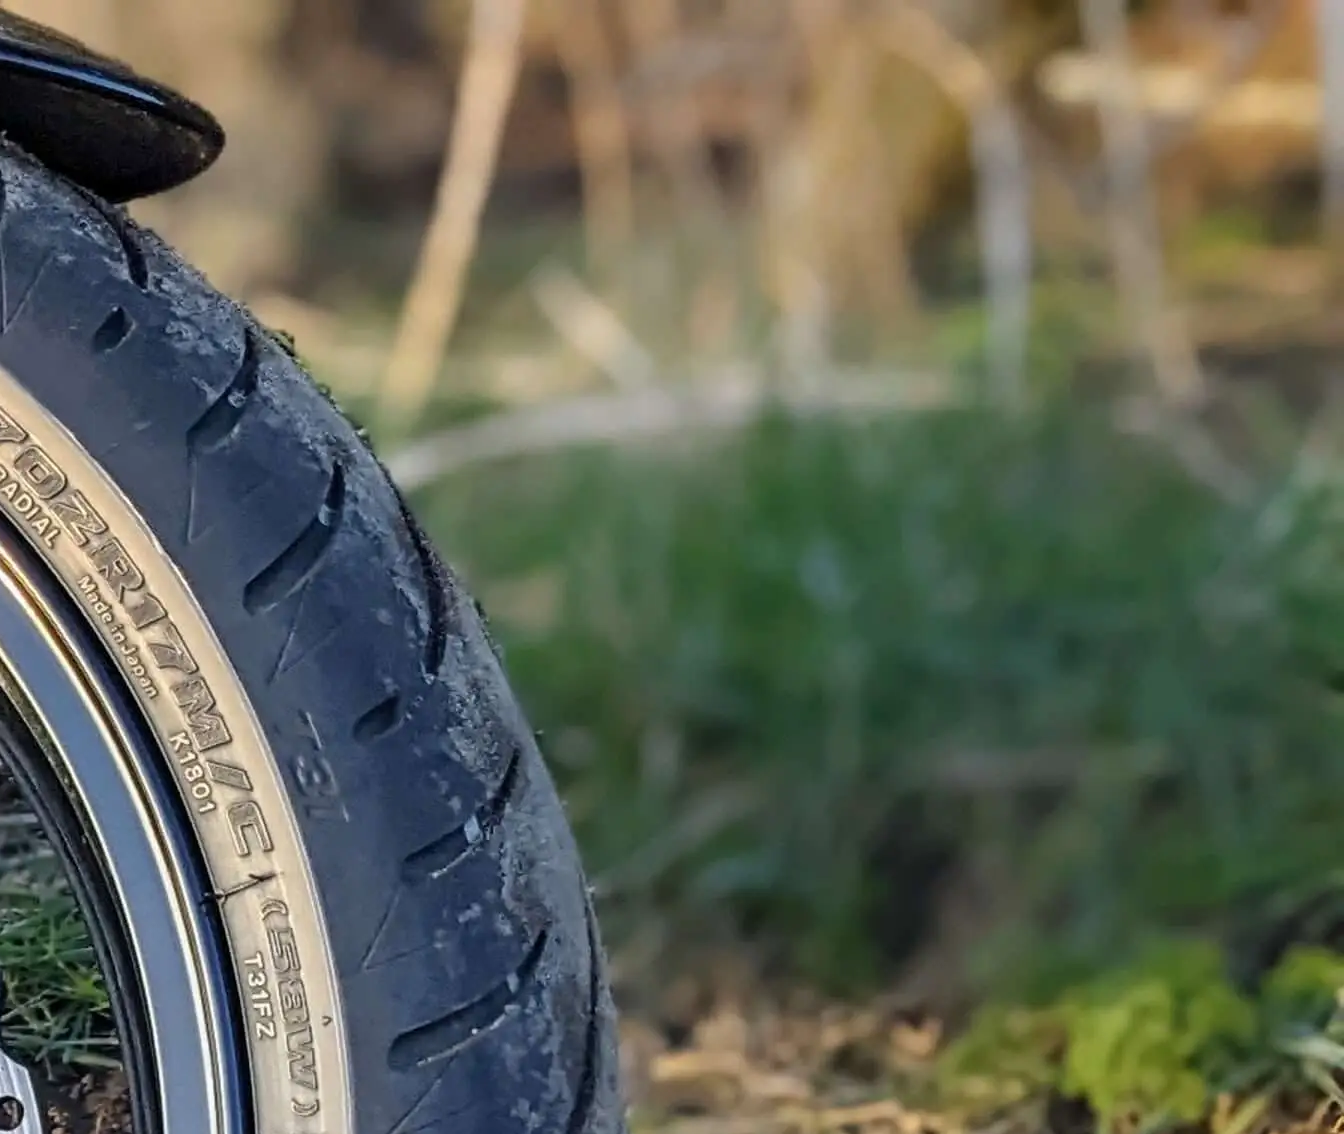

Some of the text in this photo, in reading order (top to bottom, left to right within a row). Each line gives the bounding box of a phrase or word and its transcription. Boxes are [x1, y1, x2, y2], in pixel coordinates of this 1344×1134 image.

[77, 575, 114, 623] Made
[121, 644, 160, 701] Japan
[169, 731, 217, 816] K1801
[243, 950, 277, 1041] T31FZ
